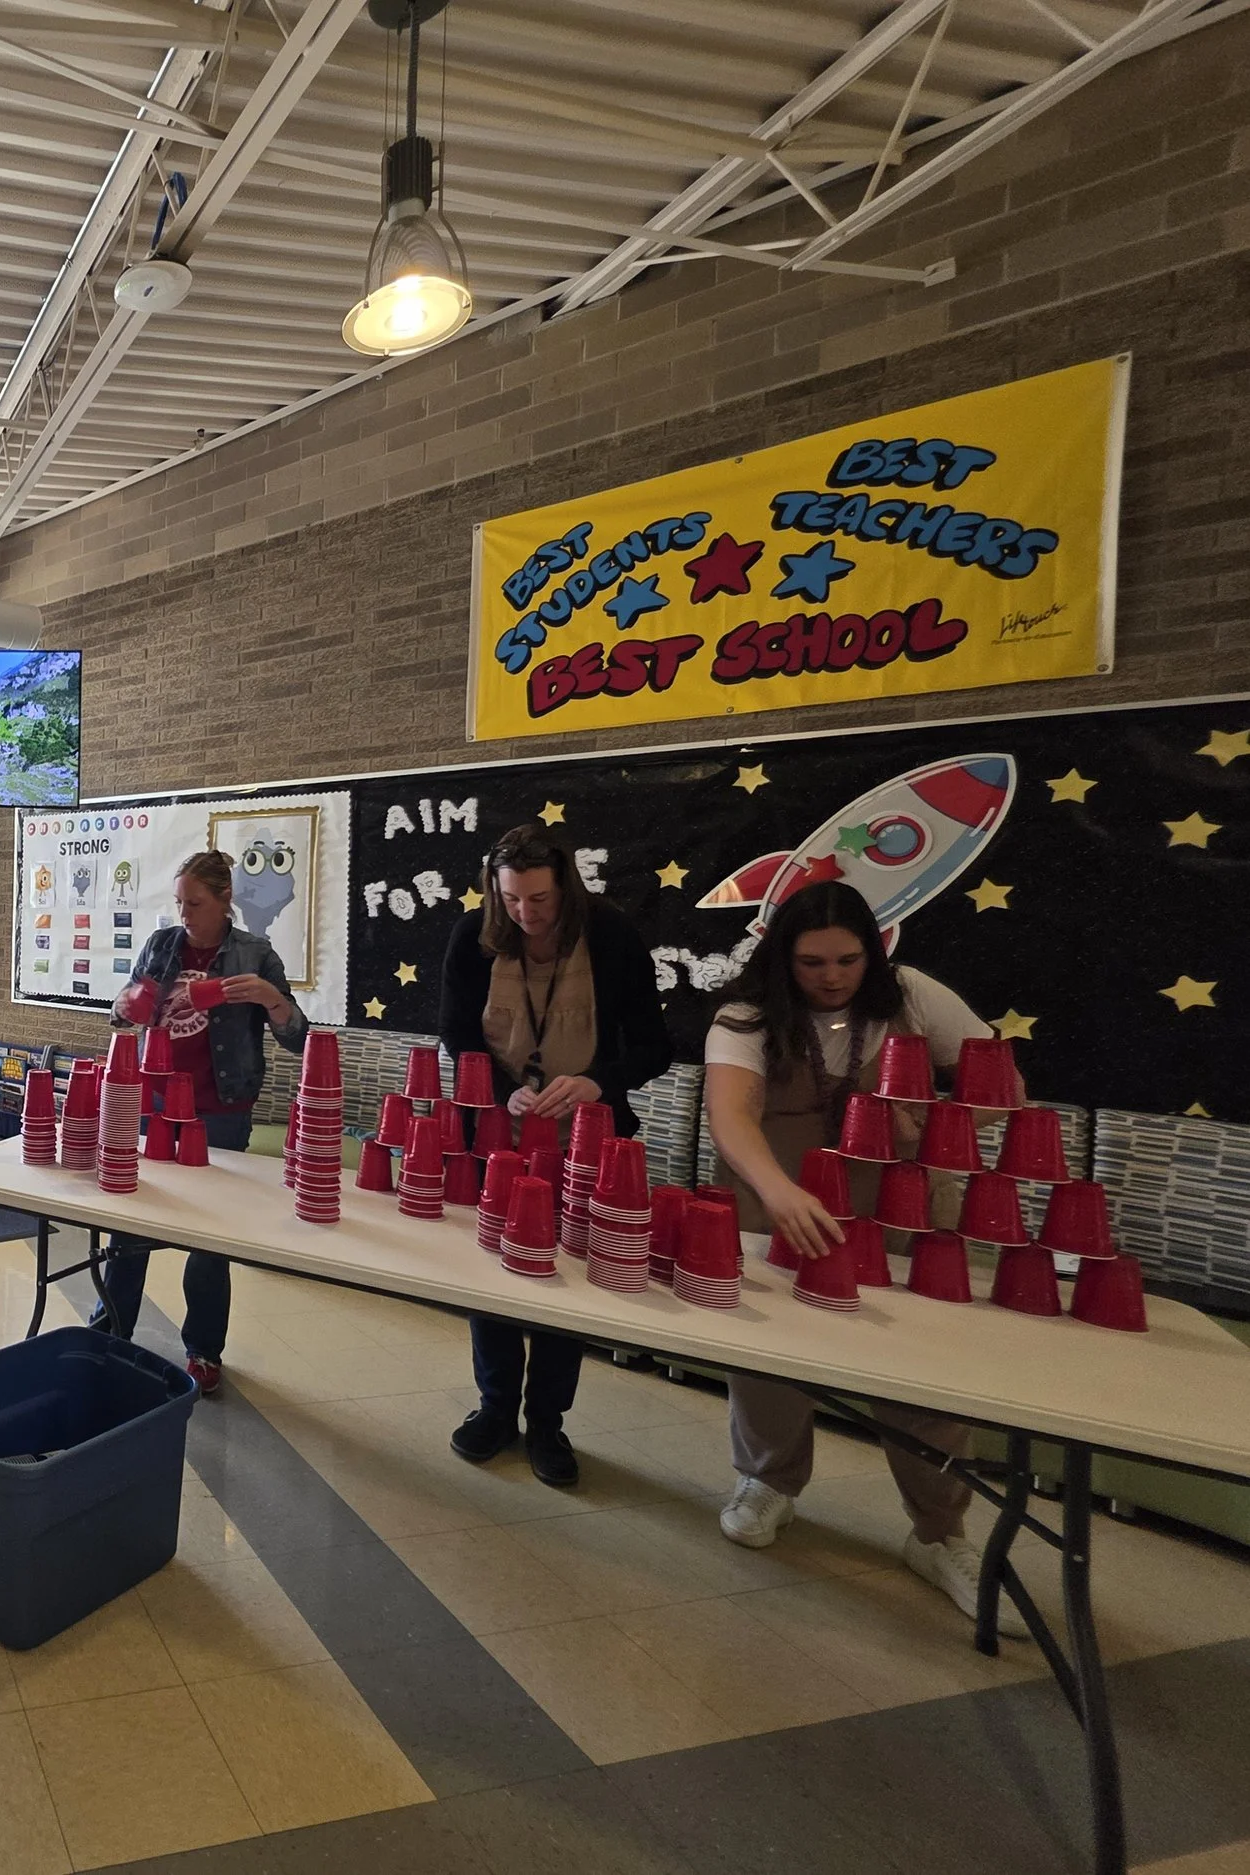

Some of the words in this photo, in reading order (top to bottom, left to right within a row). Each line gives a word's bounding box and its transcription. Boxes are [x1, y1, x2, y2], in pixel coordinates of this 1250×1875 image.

[826, 438, 996, 491] BEST
[769, 490, 1059, 580] TEACHERS
[502, 521, 593, 610] BEST
[495, 511, 712, 674] STUDENTS
[527, 634, 704, 718] BEST
[710, 598, 968, 685] SCHOOL
[28, 815, 148, 836] CHARACTER
[384, 797, 478, 840] AIM
[59, 838, 110, 856] STRONG
[364, 870, 451, 921] FOR
